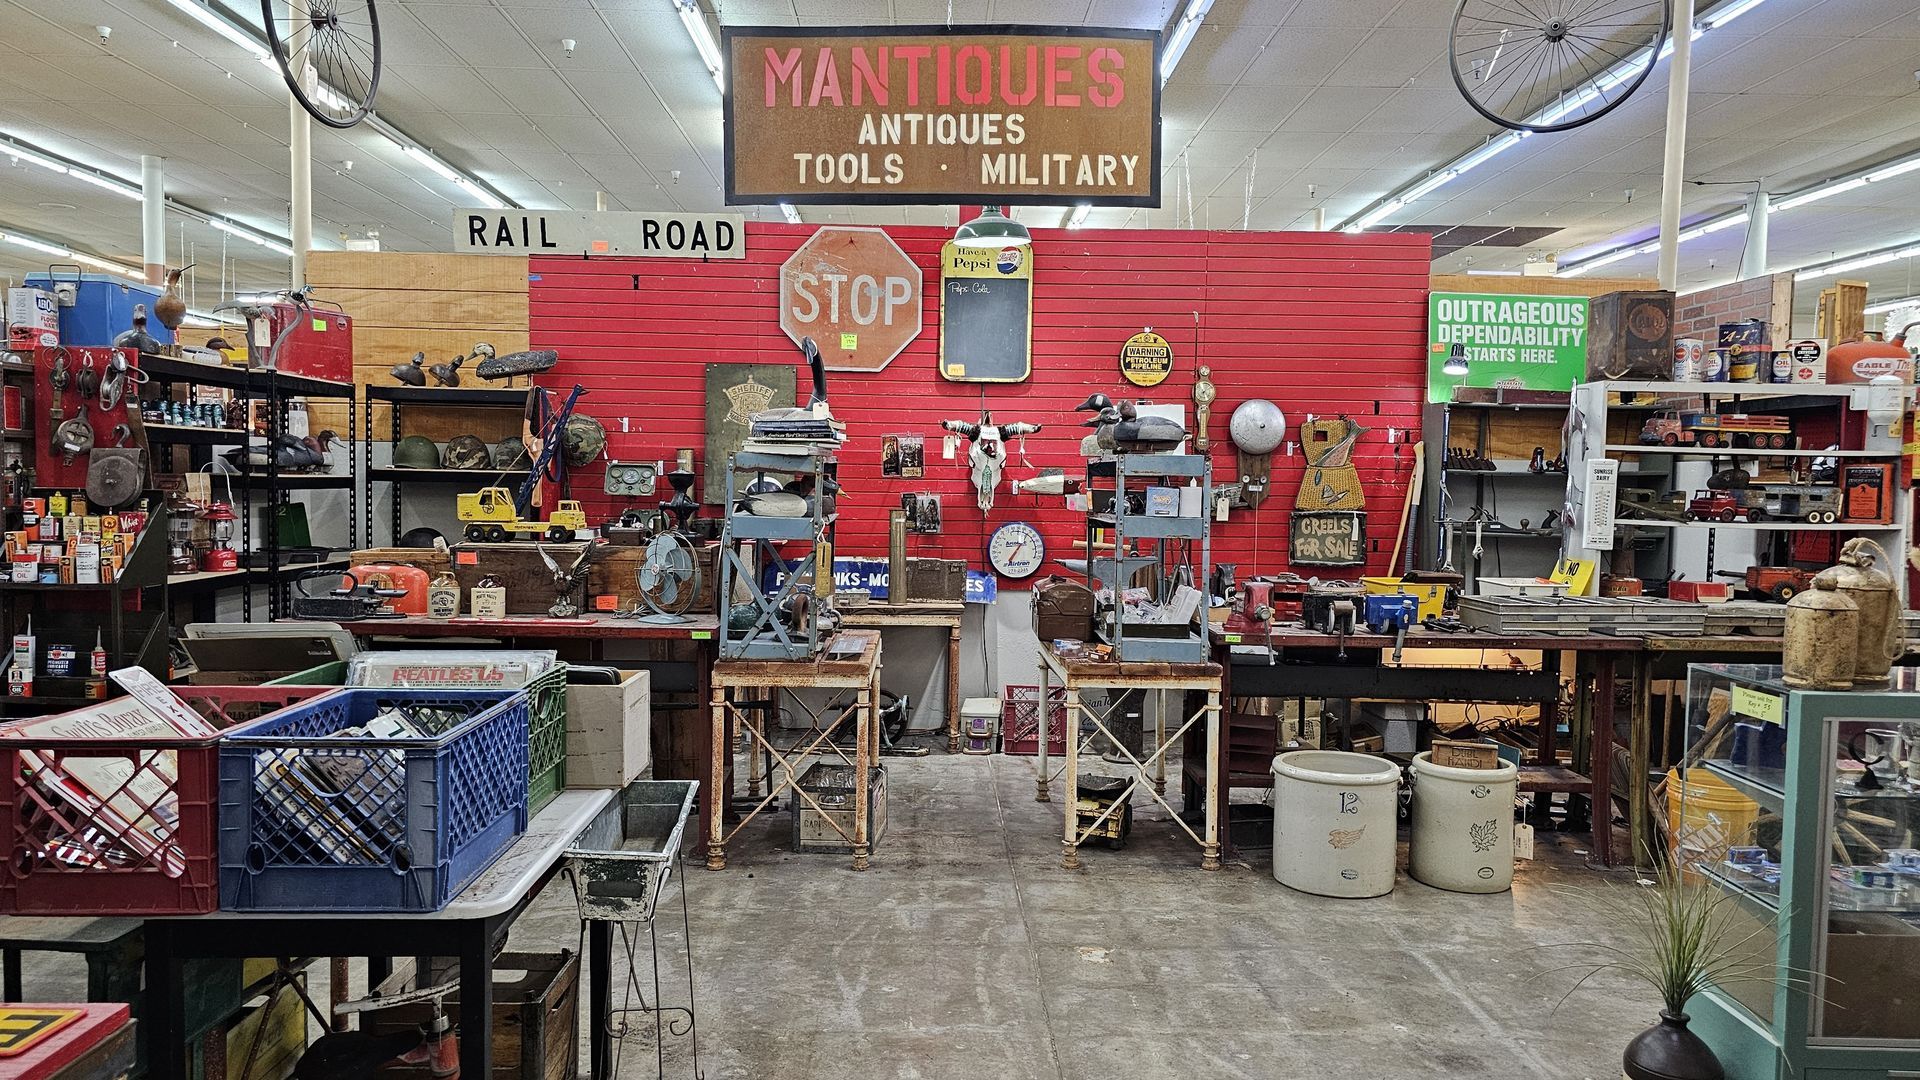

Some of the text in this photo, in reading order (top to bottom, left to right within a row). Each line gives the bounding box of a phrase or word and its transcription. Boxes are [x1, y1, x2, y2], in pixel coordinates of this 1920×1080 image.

[764, 44, 1125, 108] MANTIQUES
[858, 113, 1025, 145] ANTIQUES
[793, 153, 1139, 186] TOOLS MILITARY
[468, 215, 735, 252] RAIL ROAD
[958, 248, 980, 256] Have
[953, 257, 990, 272] Pepsi
[792, 272, 912, 326] STOP
[1437, 299, 1585, 326] OUTRAGEOUS
[1438, 323, 1584, 347] DEPENDABILITY
[1125, 356, 1168, 364] PETROLEUM
[1129, 347, 1165, 356] WARNING
[1464, 347, 1558, 364] STARTS HERE.
[729, 383, 771, 397] SHERIFF
[1301, 517, 1351, 537] CREELS
[1325, 535, 1358, 560] SALE
[1566, 562, 1580, 577] NO
[392, 666, 473, 681] BEATLES
[97, 706, 154, 737] Borax
[1474, 784, 1487, 799] 8
[1339, 791, 1359, 815] 12
